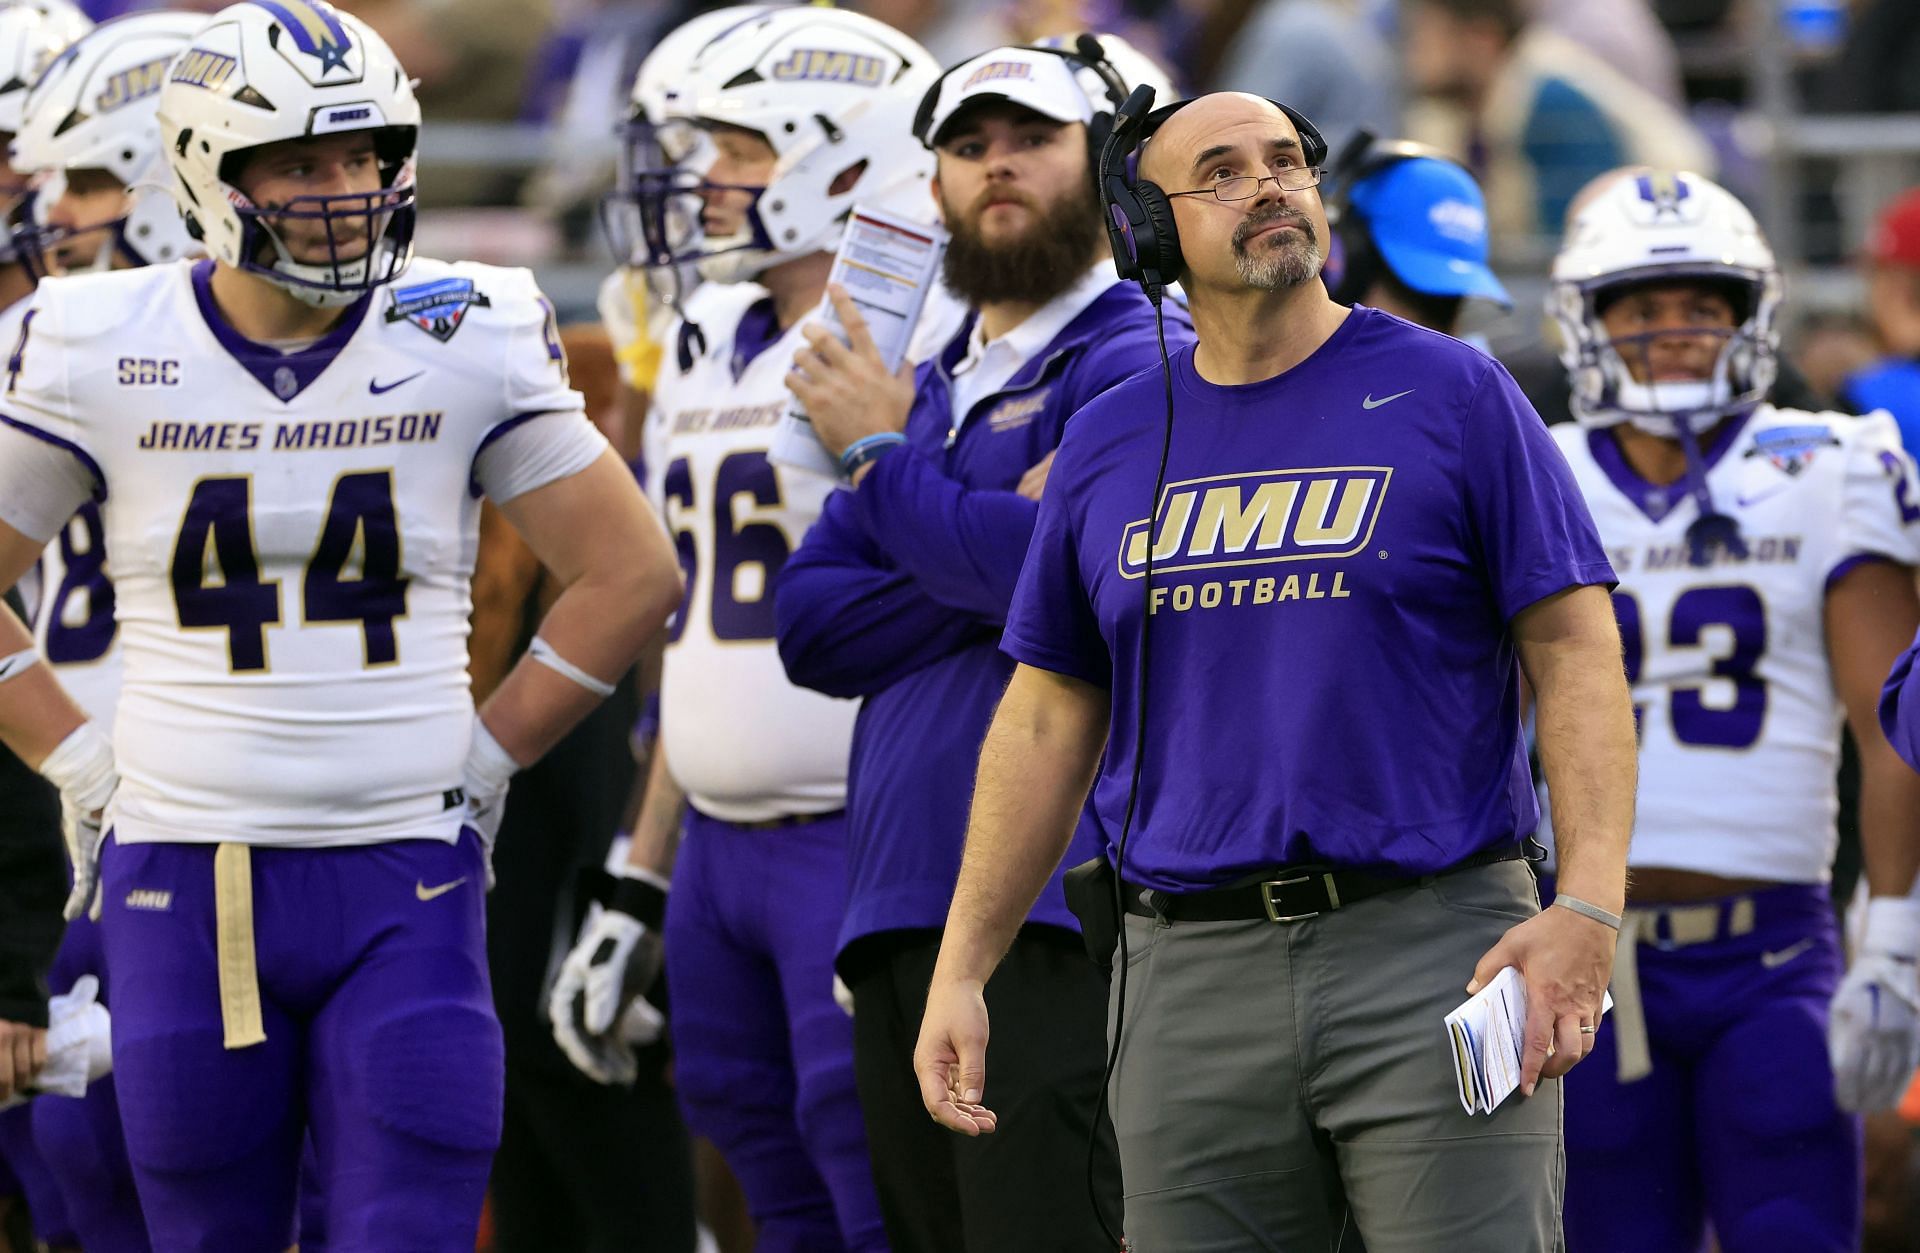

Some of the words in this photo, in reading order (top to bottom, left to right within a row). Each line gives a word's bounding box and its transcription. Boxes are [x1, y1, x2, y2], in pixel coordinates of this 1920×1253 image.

[97, 55, 172, 114] JM
[773, 49, 886, 88] JMU
[117, 357, 180, 386] SBC
[138, 421, 262, 449] JAMES
[273, 411, 442, 449] MADISON
[1126, 478, 1376, 567] JMU
[168, 467, 412, 675] 44
[1150, 571, 1351, 615] FOOTBALL
[125, 889, 171, 911] JMU
